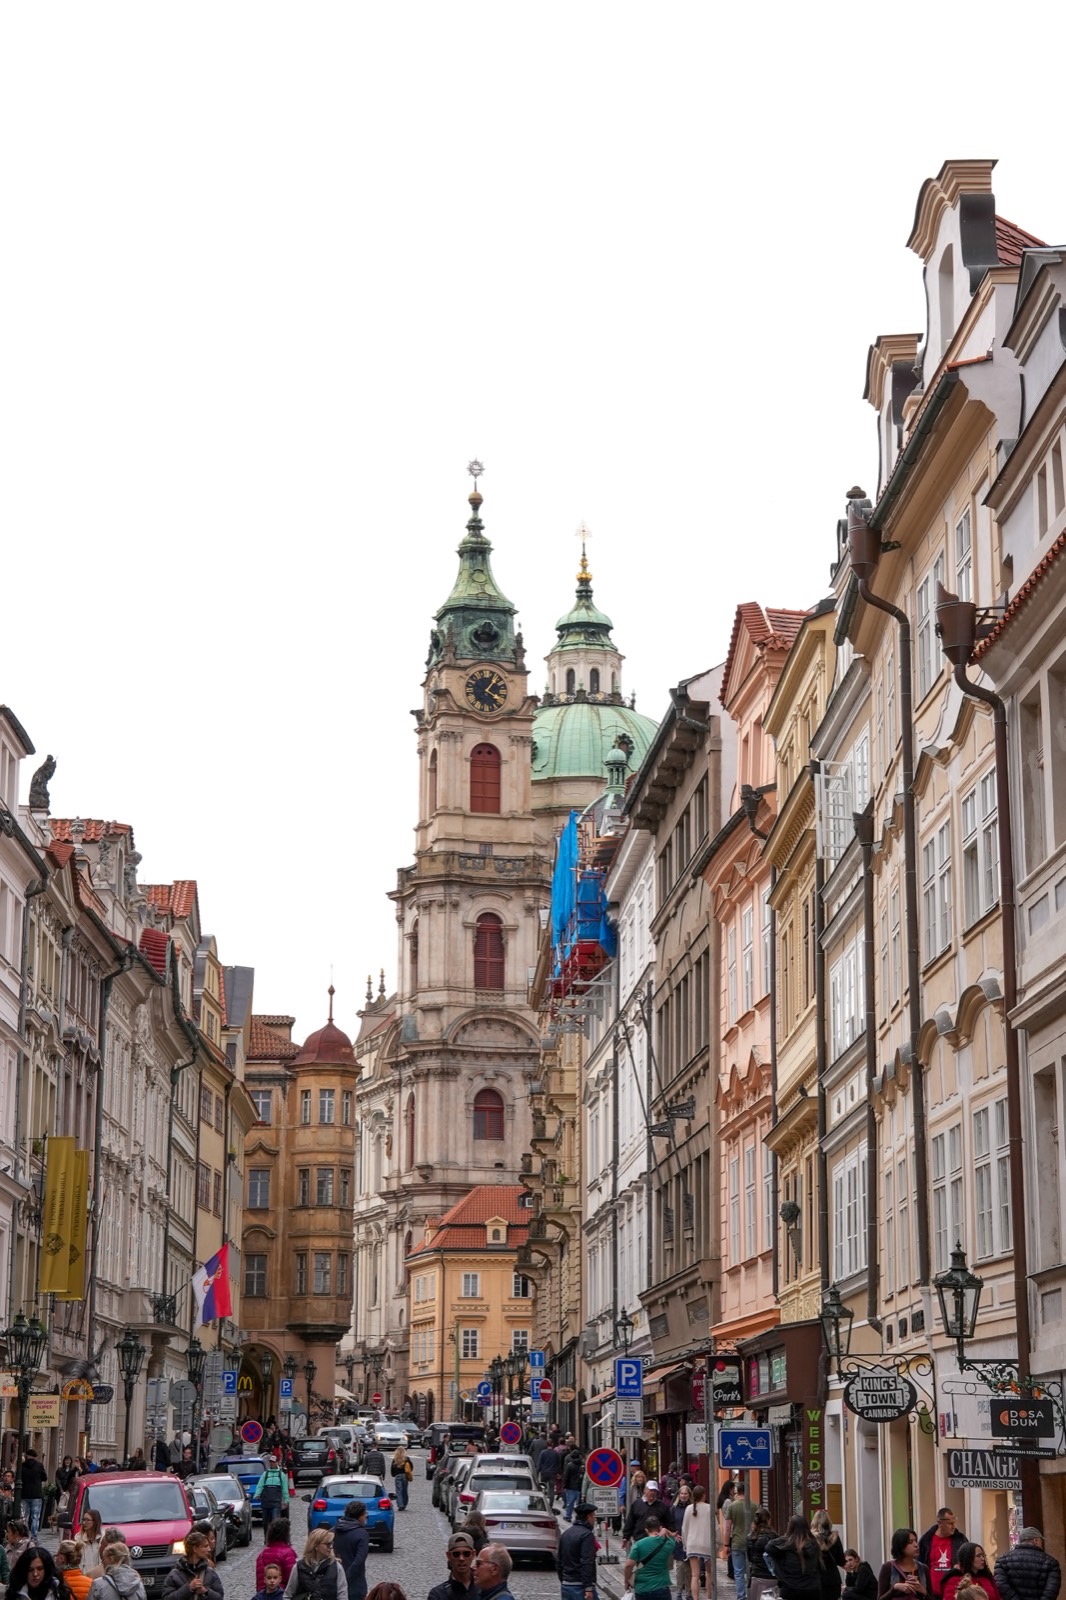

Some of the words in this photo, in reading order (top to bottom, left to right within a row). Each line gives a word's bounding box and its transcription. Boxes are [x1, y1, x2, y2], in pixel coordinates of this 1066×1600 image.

[621, 1363, 637, 1386] P
[862, 1377, 896, 1391] KING'S
[863, 1393, 897, 1405] TOWN
[863, 1408, 899, 1418] CANNABIS
[1010, 1410, 1044, 1419] DOSA
[1010, 1418, 1038, 1427] DUM
[950, 1451, 1019, 1478] CHANGE
[961, 1480, 1020, 1489] COMMISSION
